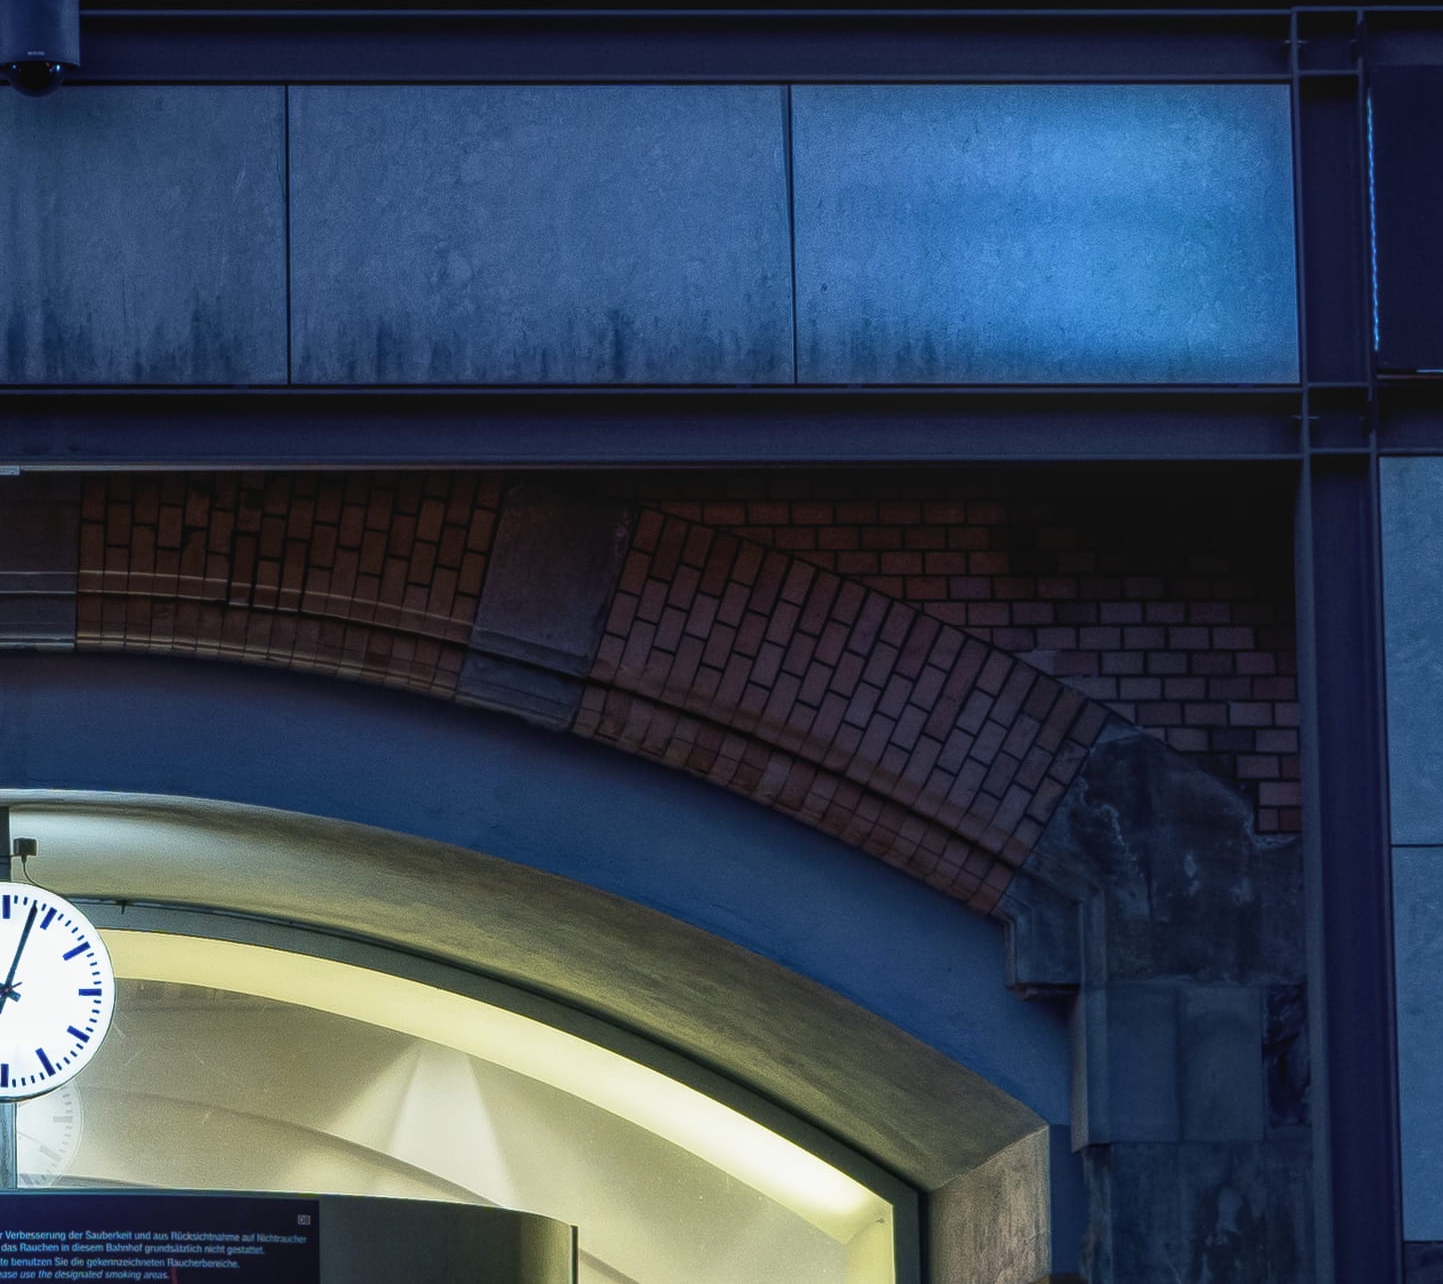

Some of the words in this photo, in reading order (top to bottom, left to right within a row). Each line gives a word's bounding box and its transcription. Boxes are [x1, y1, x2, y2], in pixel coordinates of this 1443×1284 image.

[5, 1230, 66, 1241] Verbesserung
[68, 1231, 83, 1240] der
[85, 1231, 132, 1240] Sauberkeit
[134, 1232, 151, 1240] und
[153, 1233, 168, 1241] aus
[171, 1232, 240, 1242] Rücksichtnahme
[242, 1233, 254, 1242] auf
[257, 1233, 307, 1244] Nichtraucher
[1, 1243, 18, 1252] das
[20, 1243, 59, 1252] Rauchen
[61, 1243, 69, 1252] in
[71, 1243, 103, 1252] diesem
[106, 1243, 143, 1252] Bahnhof
[144, 1245, 202, 1255] grundsätzlich
[204, 1245, 225, 1254] nicht
[227, 1246, 264, 1255] gestattet.
[11, 1258, 52, 1267] benutzen
[54, 1258, 68, 1267] Sie
[71, 1258, 84, 1267] die
[87, 1258, 164, 1268] gekennzeichneten
[167, 1258, 240, 1269] Raucherbereiche.
[19, 1271, 36, 1279] use
[38, 1270, 52, 1279] the
[54, 1270, 103, 1280] designated
[105, 1270, 141, 1280] smoking
[144, 1271, 169, 1279] areas.
